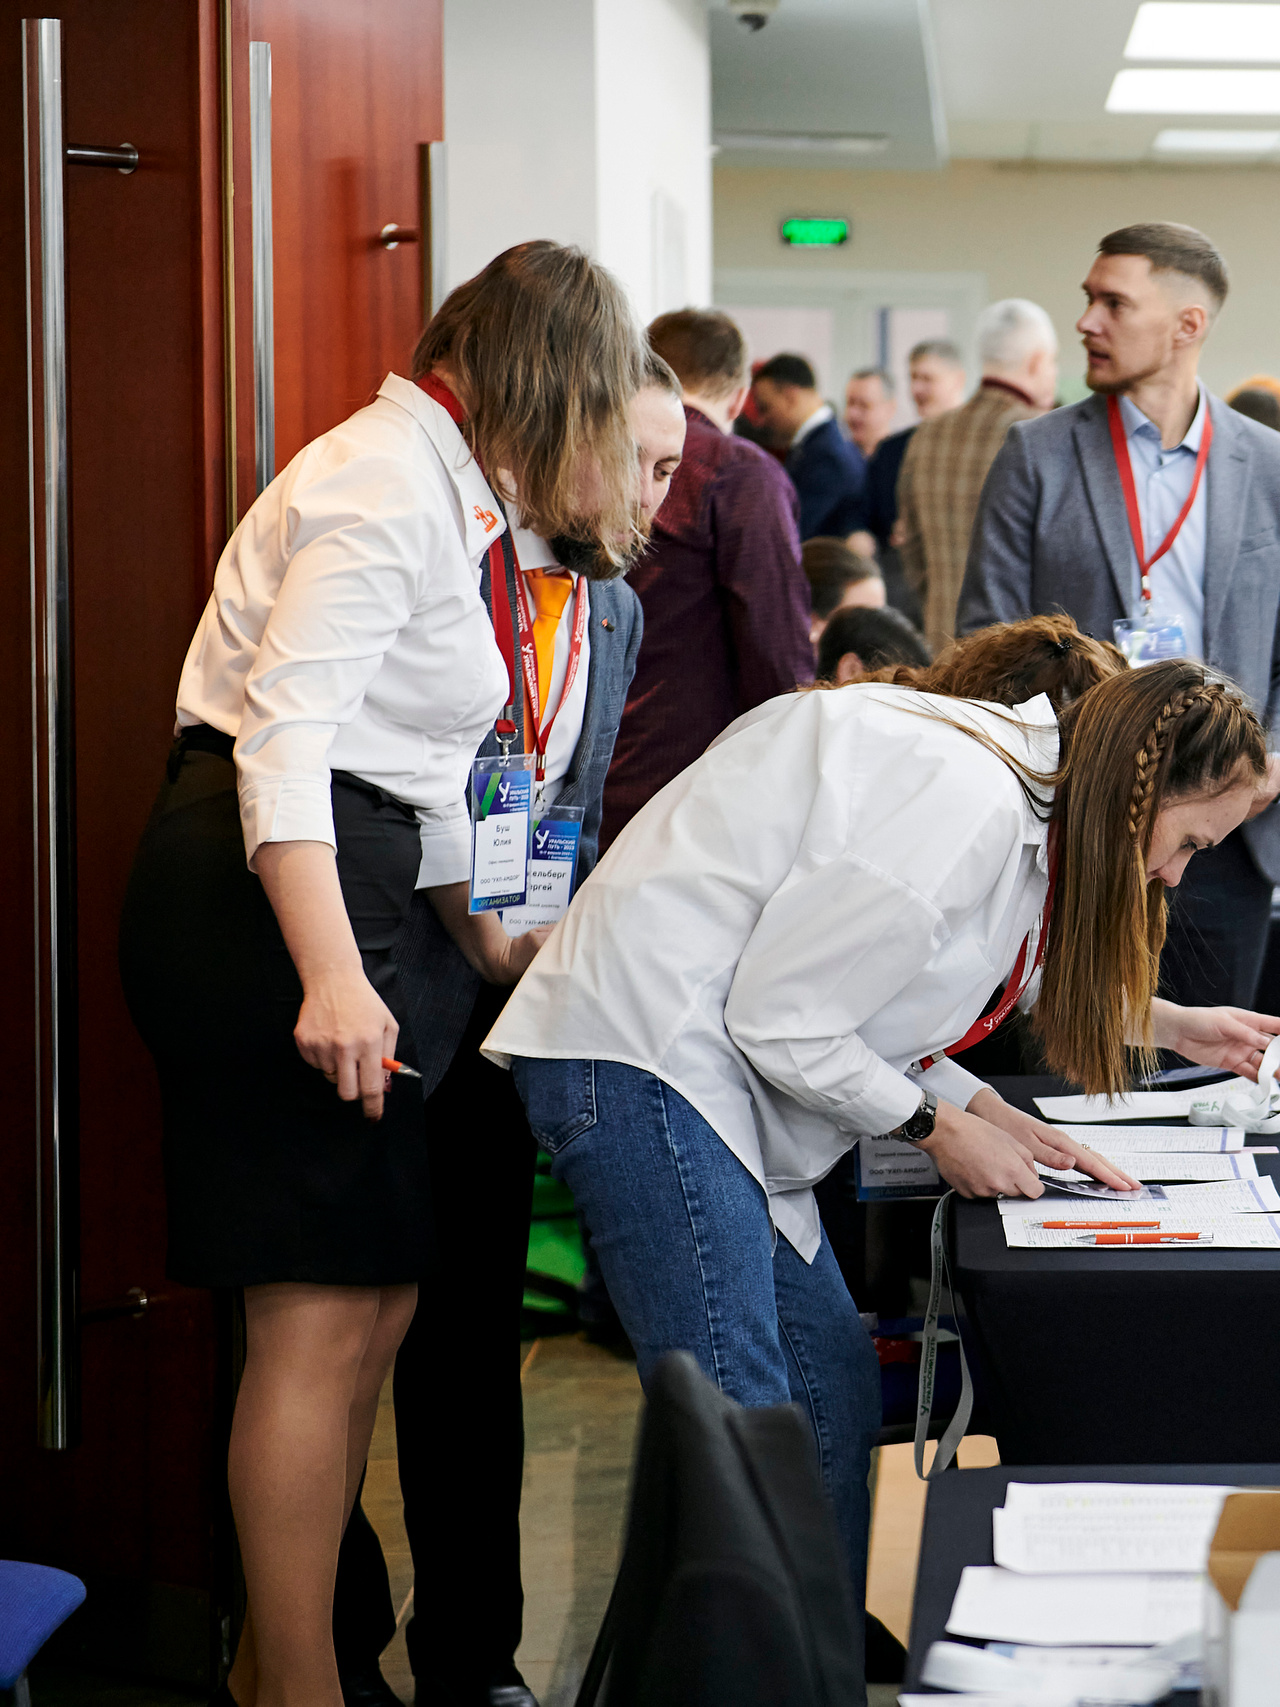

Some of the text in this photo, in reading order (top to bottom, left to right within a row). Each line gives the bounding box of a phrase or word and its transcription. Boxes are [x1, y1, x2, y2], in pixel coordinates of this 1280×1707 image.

[496, 824, 511, 834] Буш
[493, 838, 512, 847] Юлия
[478, 894, 521, 908] ОРГАНИЗАТОР
[926, 1358, 934, 1405] УРАЛЬСКИЙ
